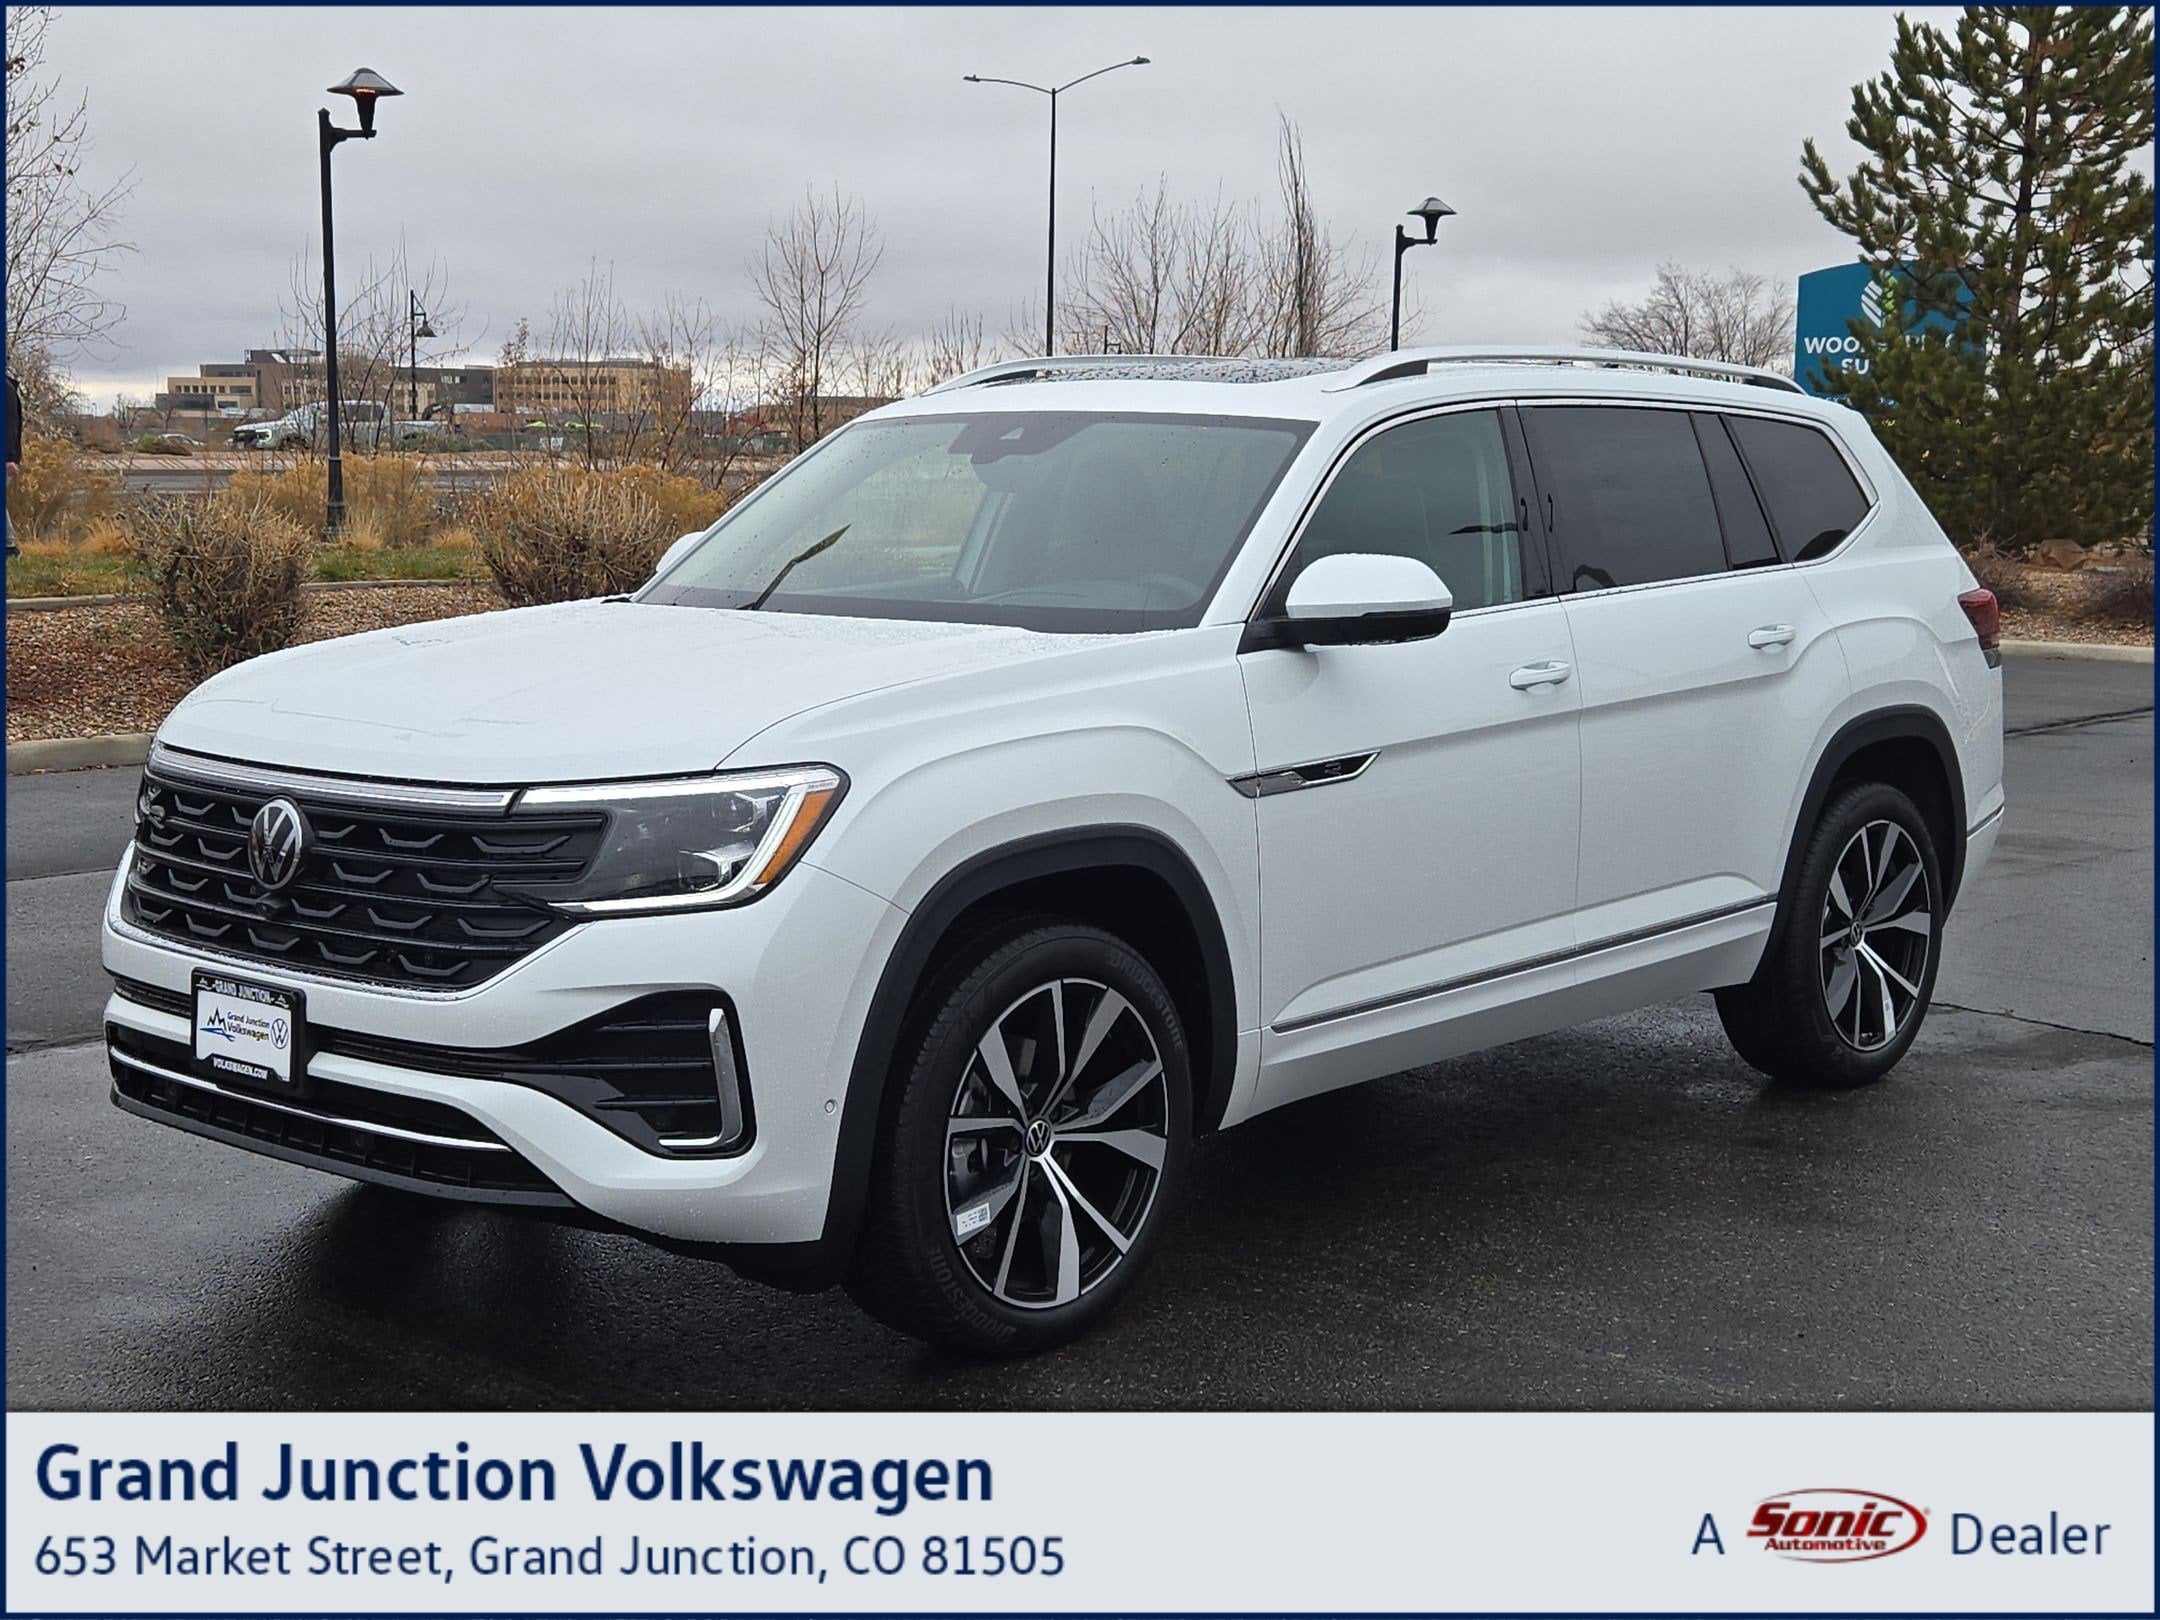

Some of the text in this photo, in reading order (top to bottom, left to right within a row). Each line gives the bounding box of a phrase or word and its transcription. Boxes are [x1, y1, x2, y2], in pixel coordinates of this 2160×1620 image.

[227, 1011, 270, 1029] Grand Junction
[227, 1022, 270, 1042] Volkswagen
